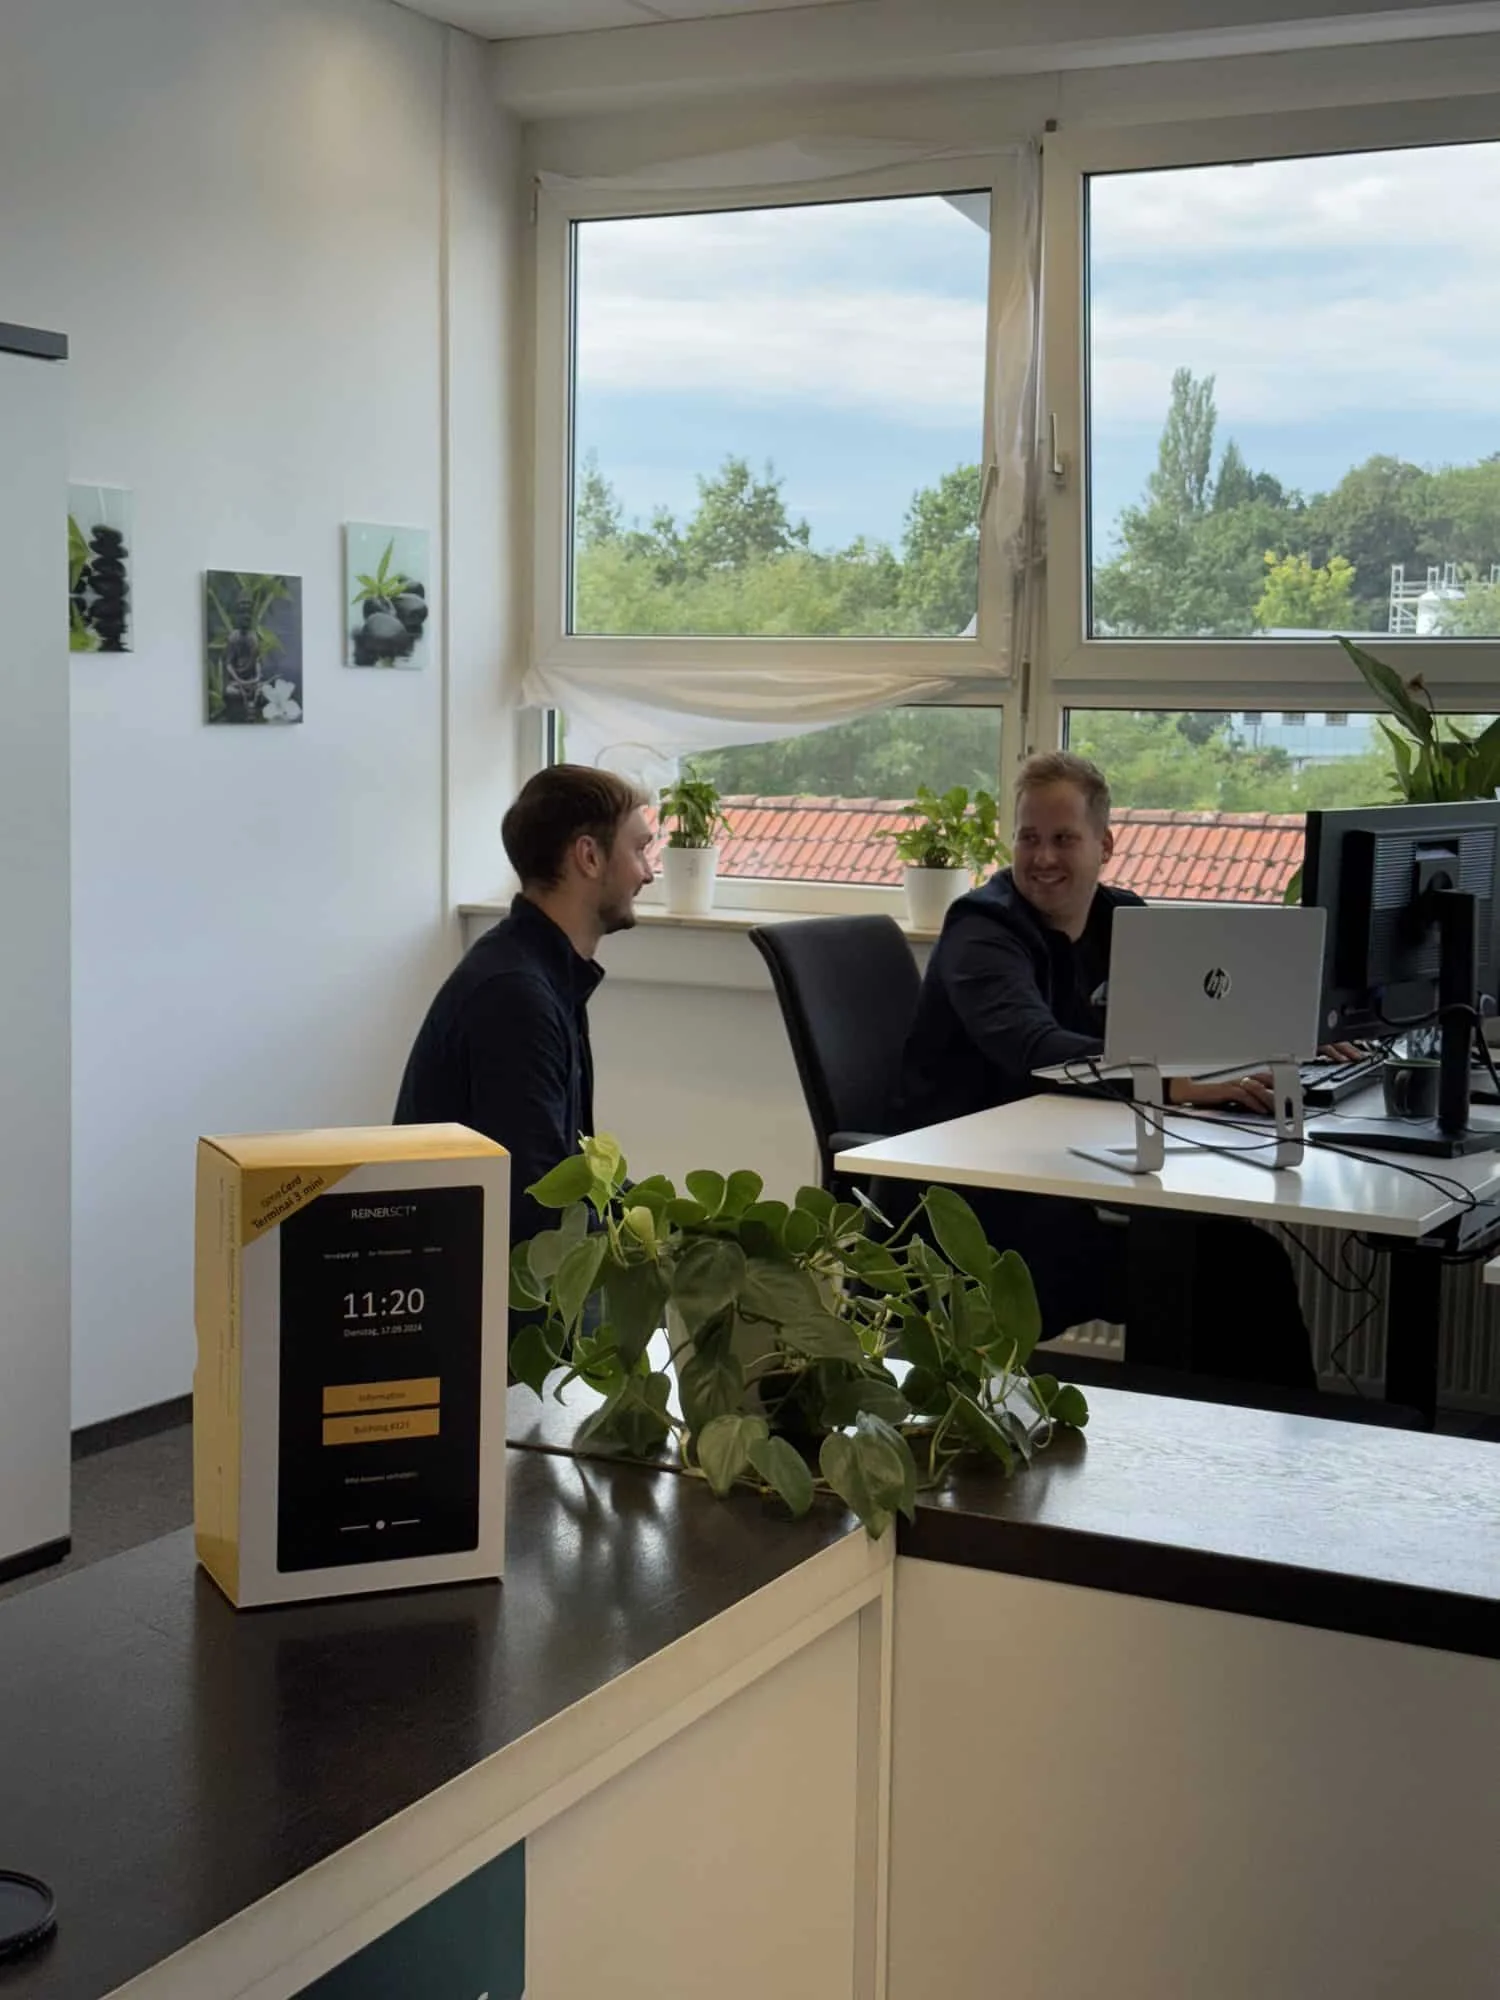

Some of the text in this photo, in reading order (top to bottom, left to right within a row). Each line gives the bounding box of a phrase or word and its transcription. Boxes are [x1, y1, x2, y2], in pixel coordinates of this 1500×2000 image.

[251, 1196, 295, 1229] Terminal
[303, 1176, 325, 1195] mini
[343, 1287, 425, 1319] 11:20
